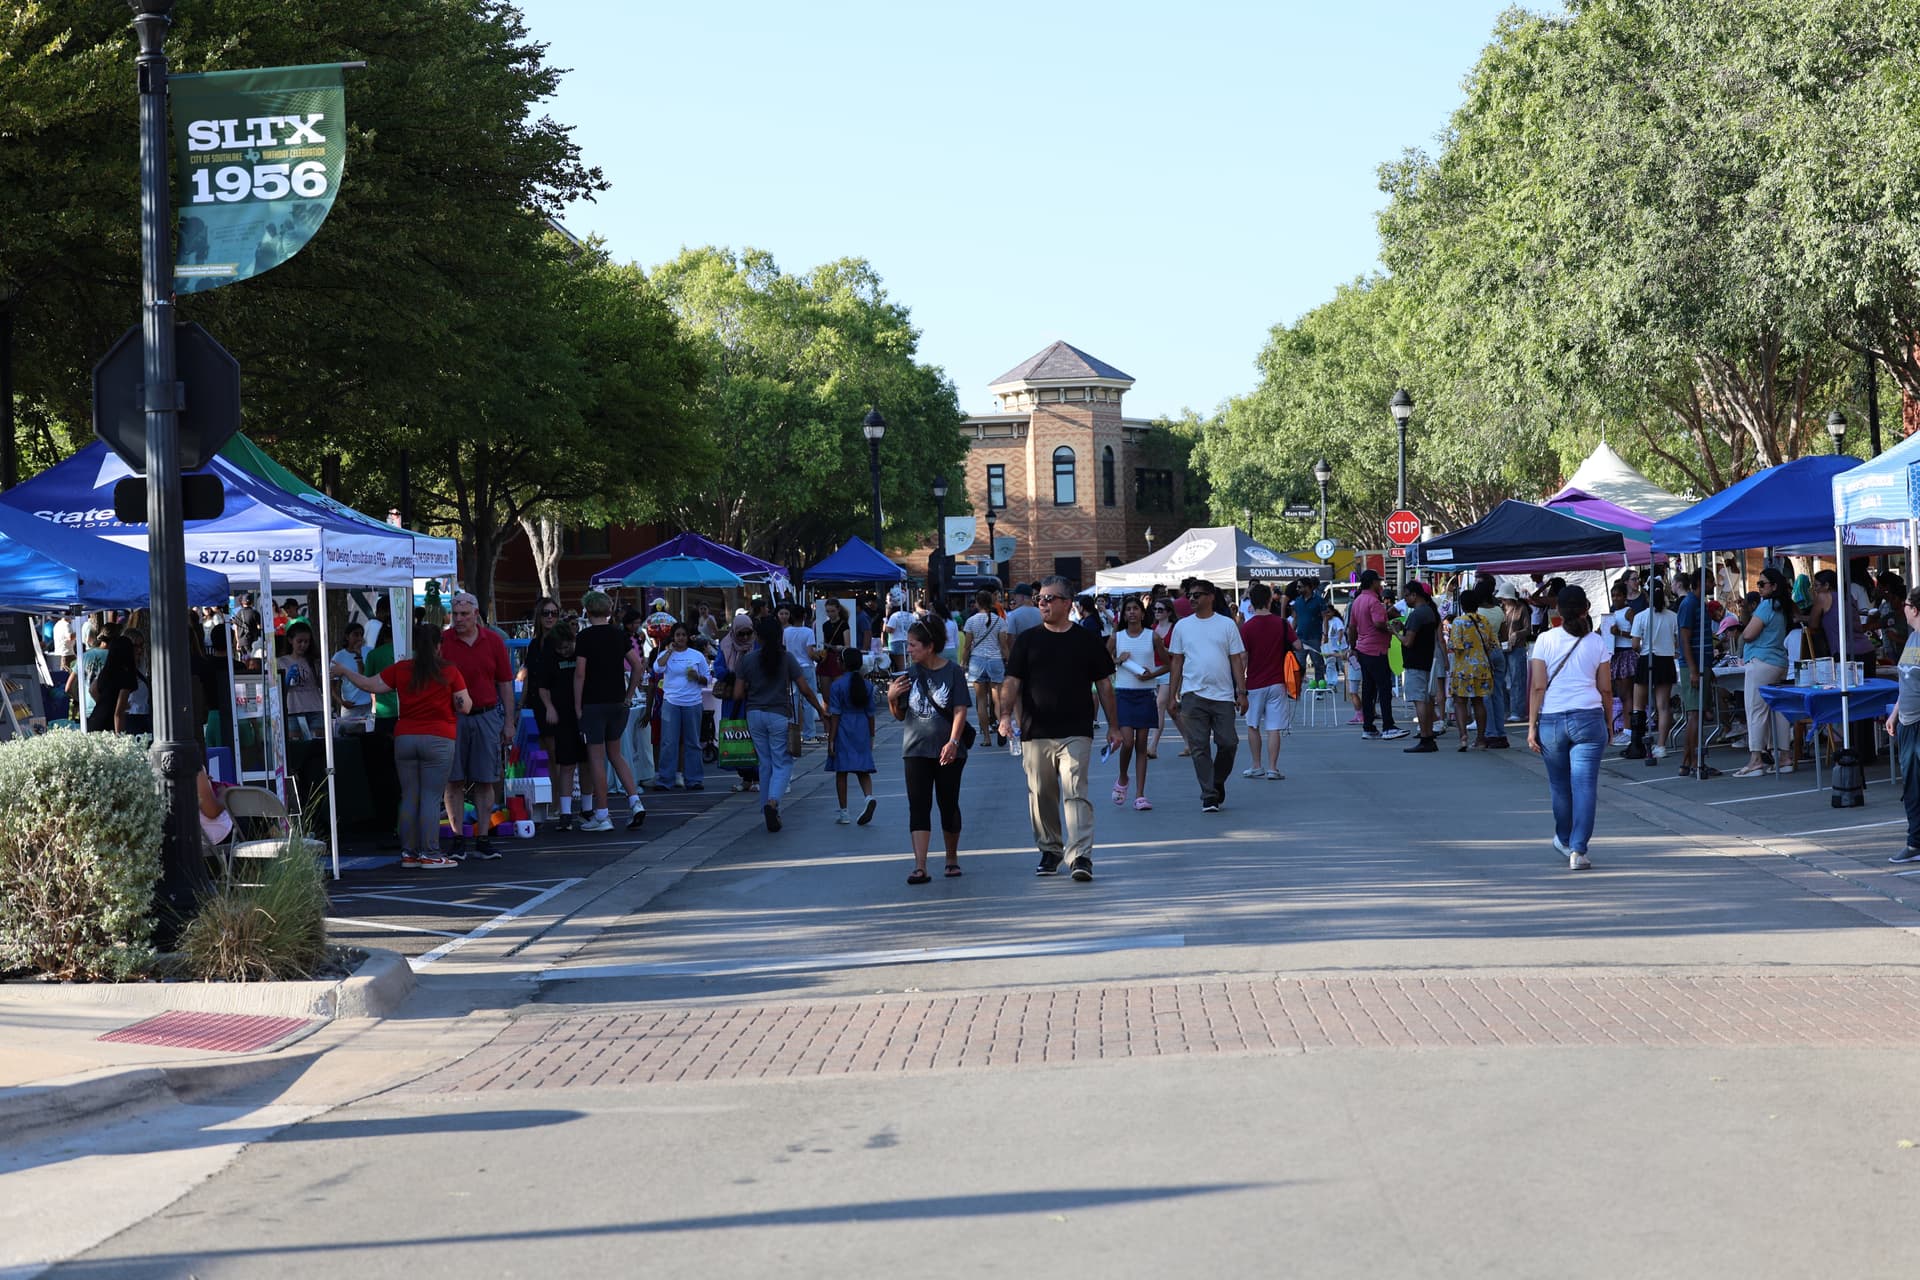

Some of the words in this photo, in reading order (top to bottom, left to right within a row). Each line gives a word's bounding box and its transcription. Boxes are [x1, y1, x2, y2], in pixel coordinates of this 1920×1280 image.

[187, 113, 326, 151] SLTX
[190, 154, 202, 164] CITY
[203, 154, 210, 164] OF
[211, 152, 242, 163] SOUTHLAKE
[192, 161, 328, 203] 1956
[1388, 521, 1418, 535] STOP
[199, 548, 313, 564] 877-60-8985
[1250, 568, 1293, 577] SOUTHLAKE
[1294, 568, 1320, 577] POLICE
[725, 730, 751, 740] WOW
